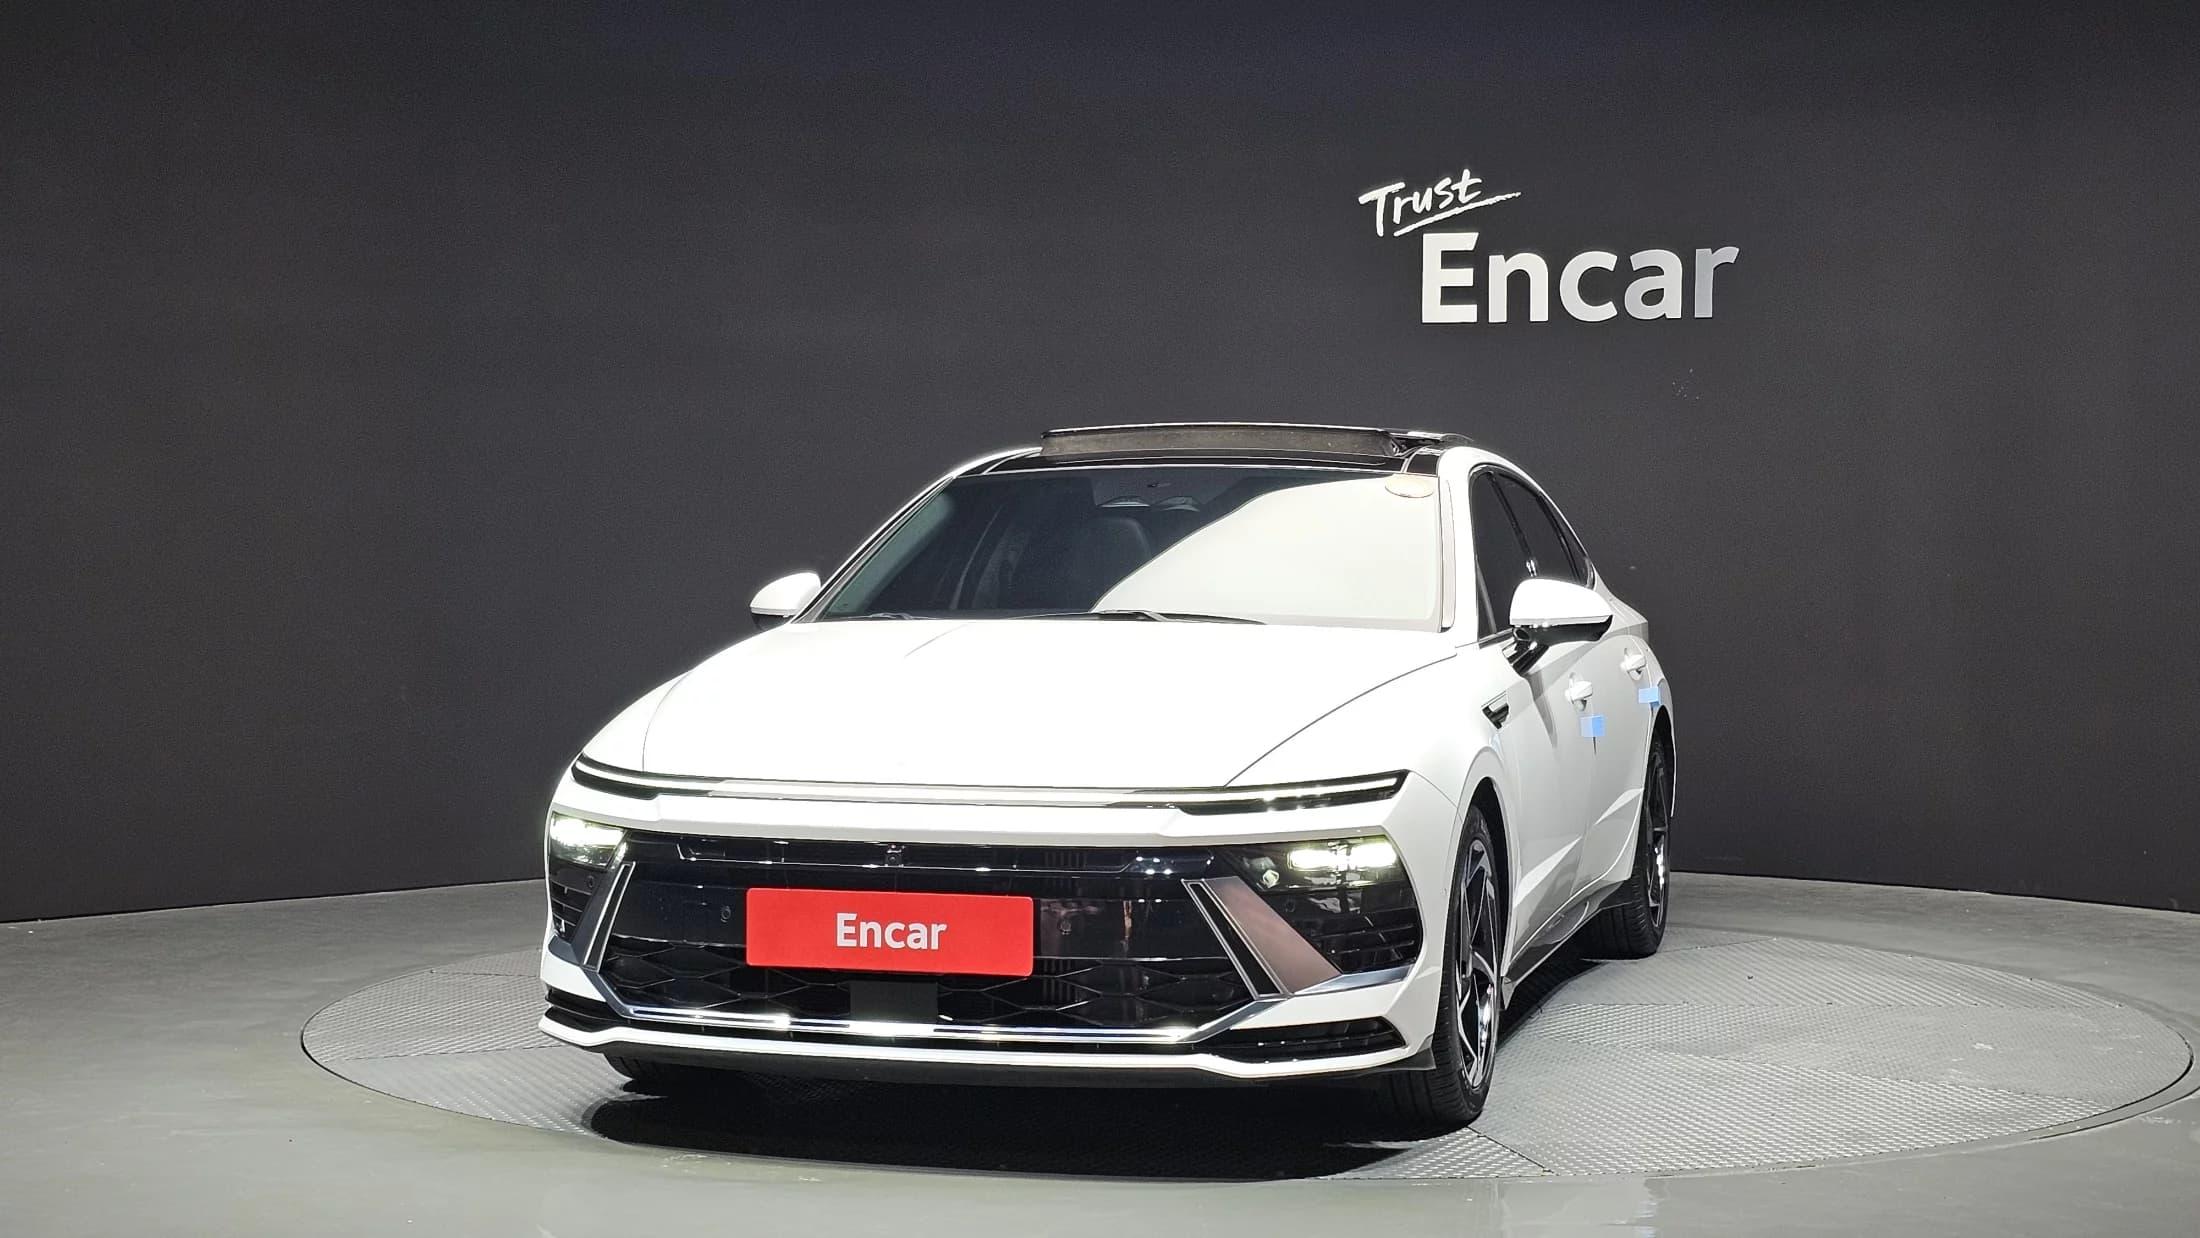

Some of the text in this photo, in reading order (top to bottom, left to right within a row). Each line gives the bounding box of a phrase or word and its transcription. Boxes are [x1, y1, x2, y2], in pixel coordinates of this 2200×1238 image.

[1358, 168, 1484, 236] Trust
[1421, 232, 1740, 323] Encar
[836, 912, 947, 950] Encar
